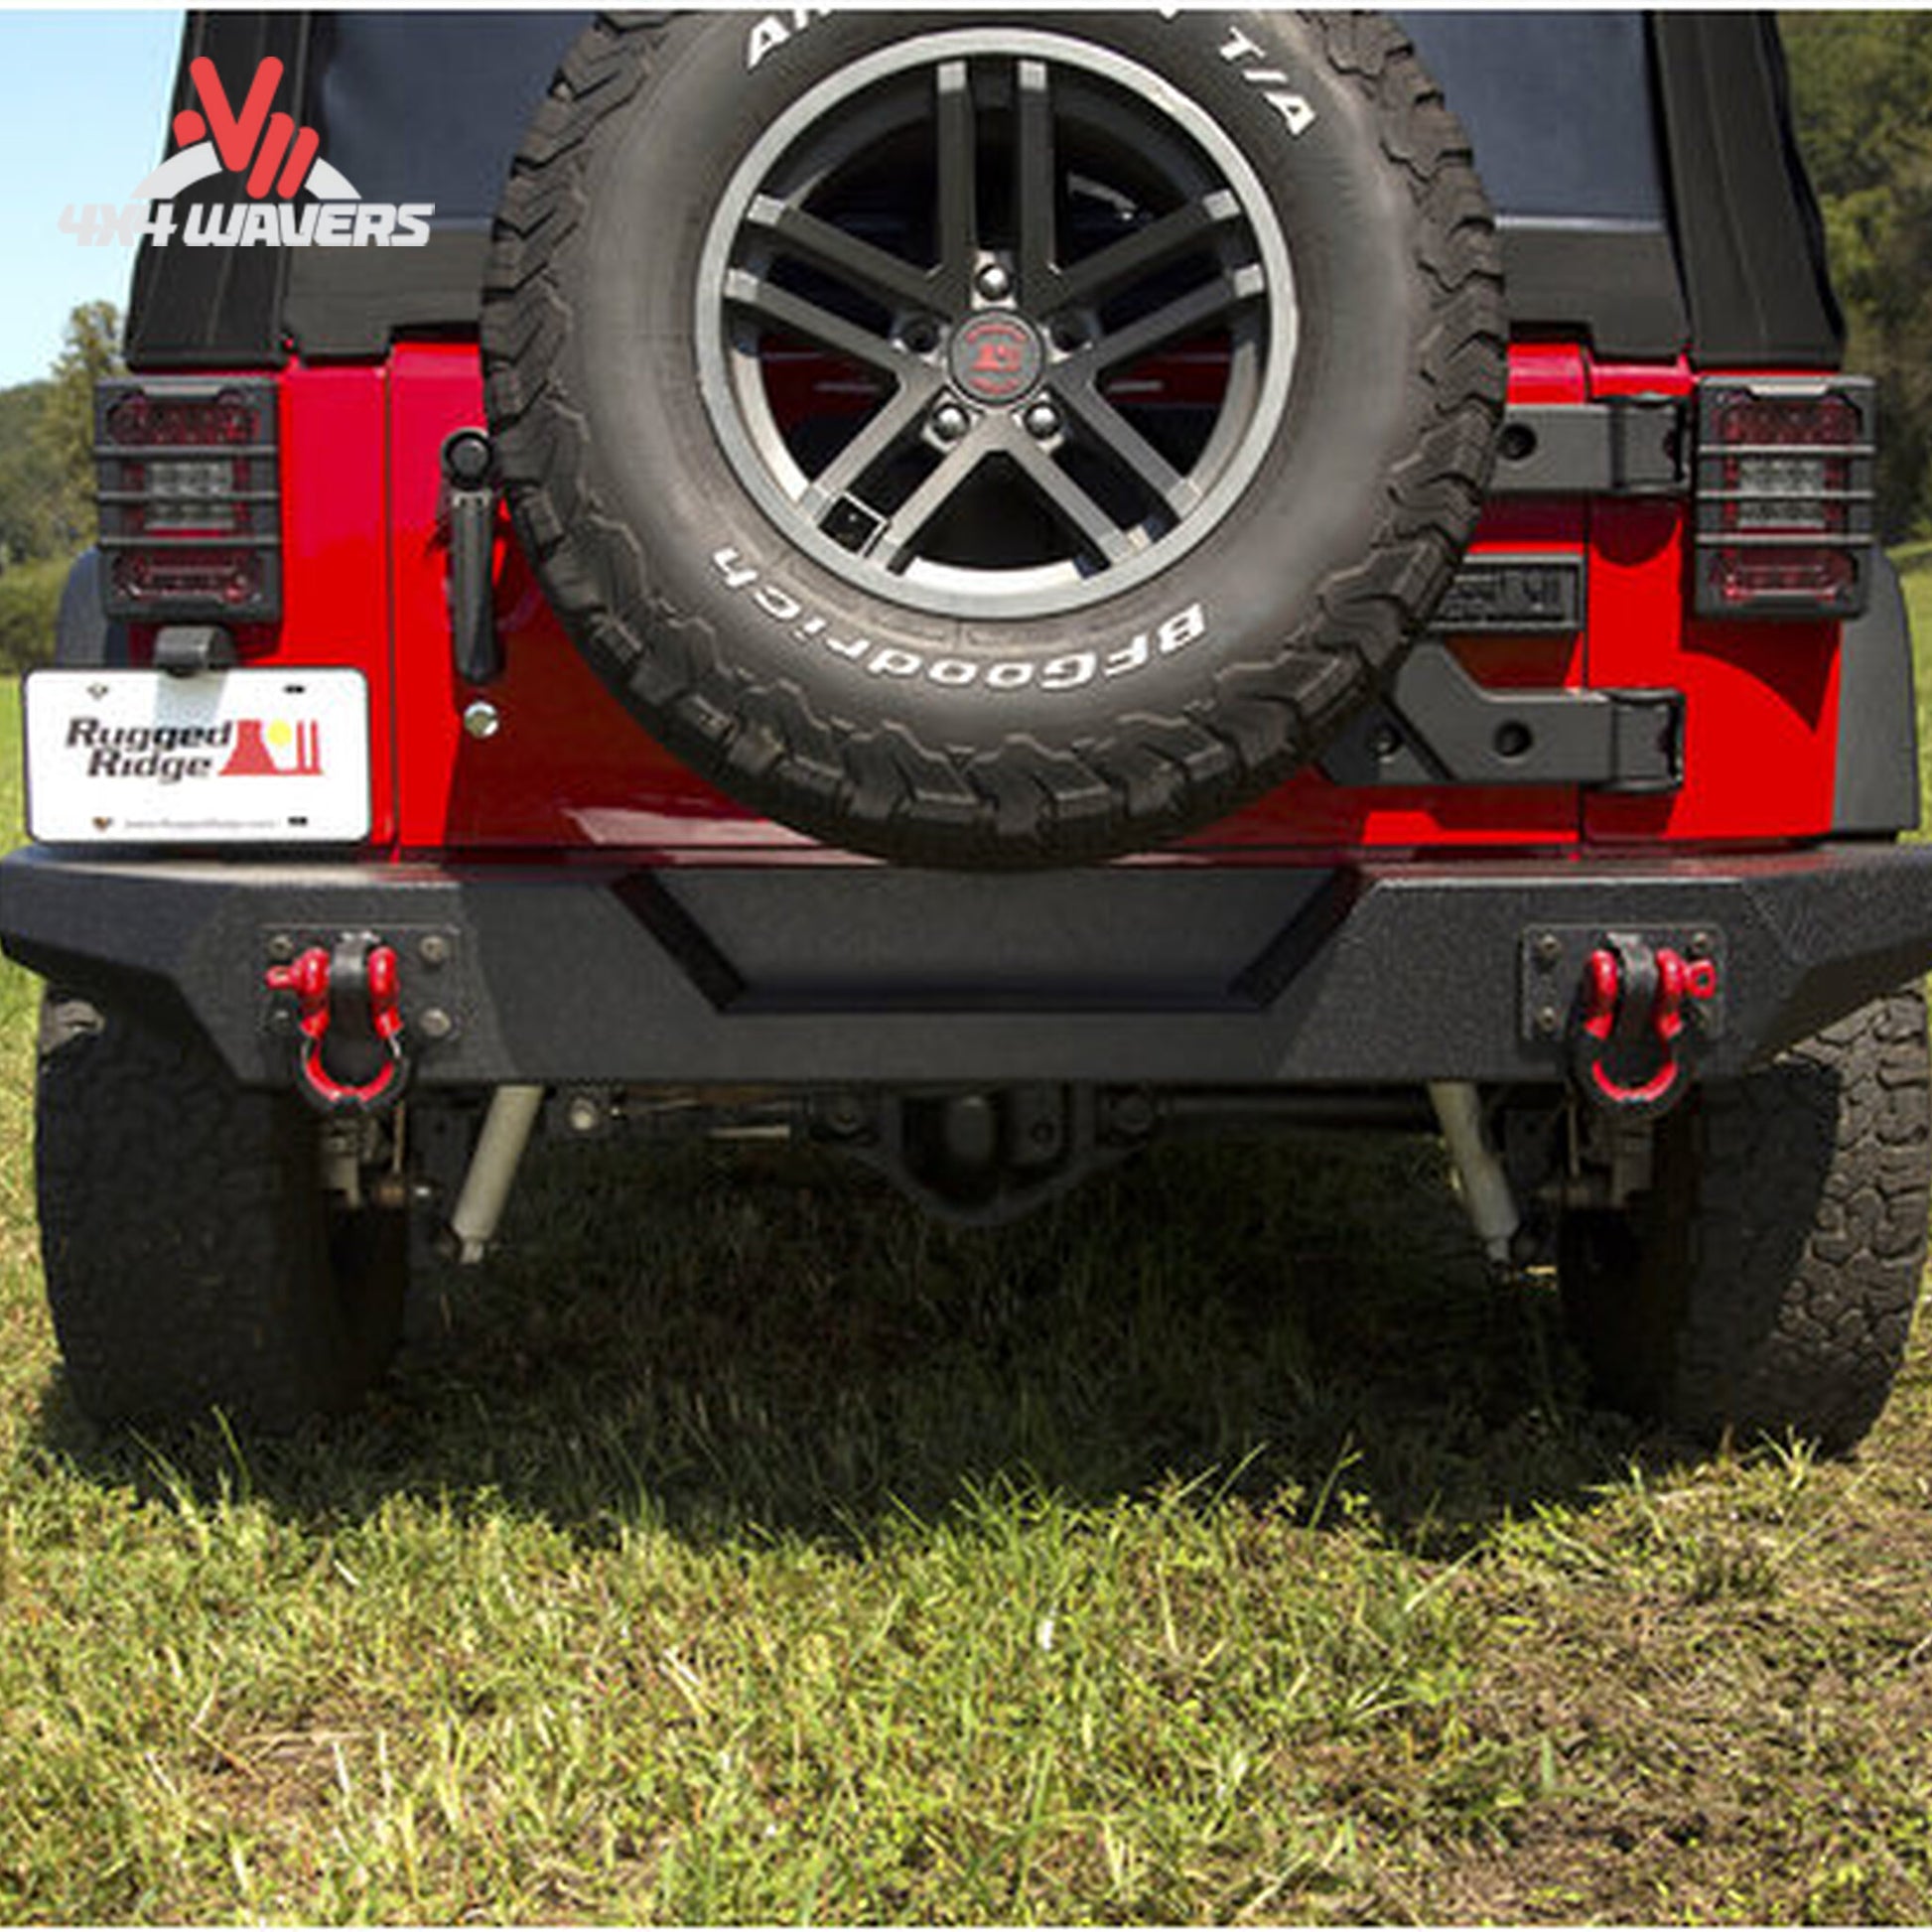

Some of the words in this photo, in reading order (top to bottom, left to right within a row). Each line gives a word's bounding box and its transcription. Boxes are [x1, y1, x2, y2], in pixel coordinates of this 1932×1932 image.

[1220, 26, 1316, 135] T/A
[712, 545, 1208, 689] BFGoodrich
[67, 717, 233, 752] Rugged
[87, 748, 212, 784] Ridge
